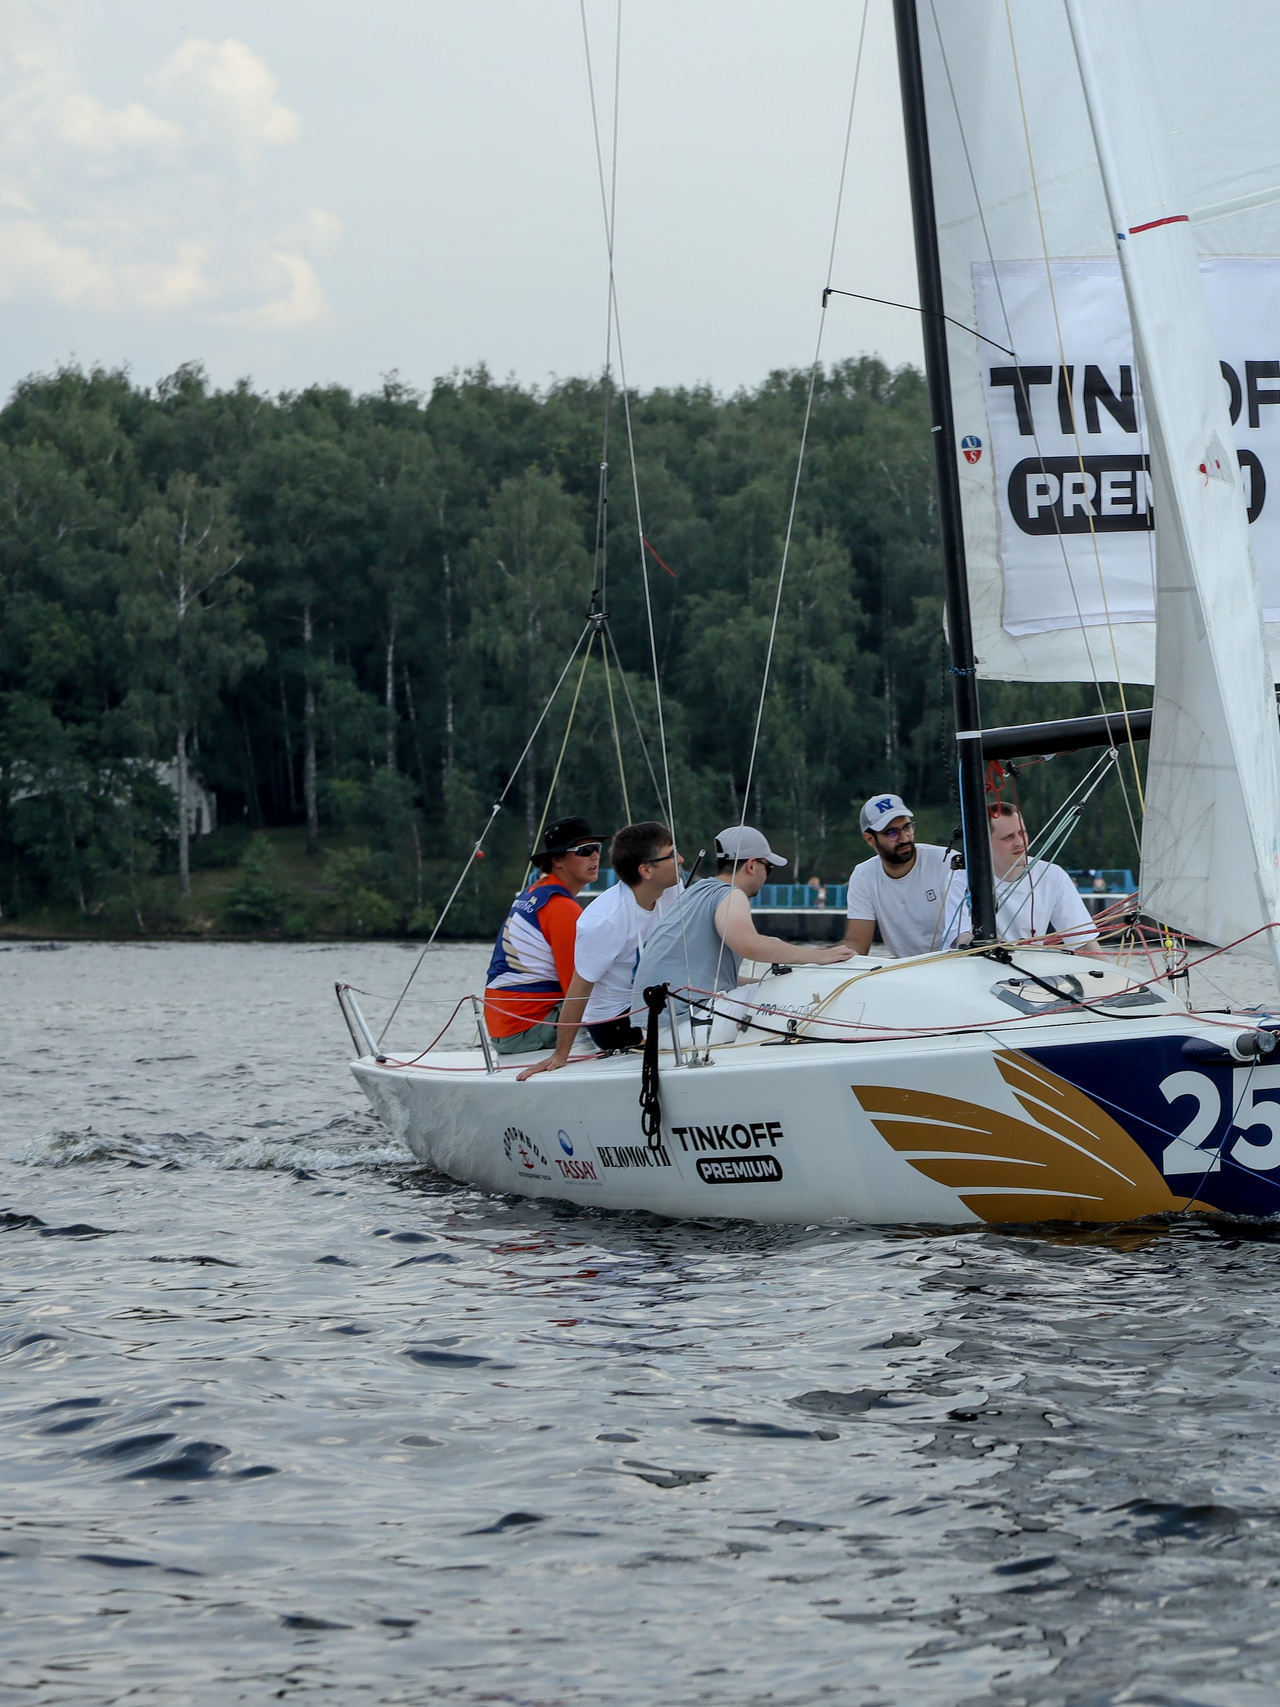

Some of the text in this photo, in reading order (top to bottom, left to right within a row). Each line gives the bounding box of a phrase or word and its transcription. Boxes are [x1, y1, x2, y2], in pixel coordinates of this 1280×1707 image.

[671, 1121, 784, 1151] TINKOFF
[555, 1160, 598, 1180] TASSAY
[700, 1160, 779, 1179] PREMIUM
